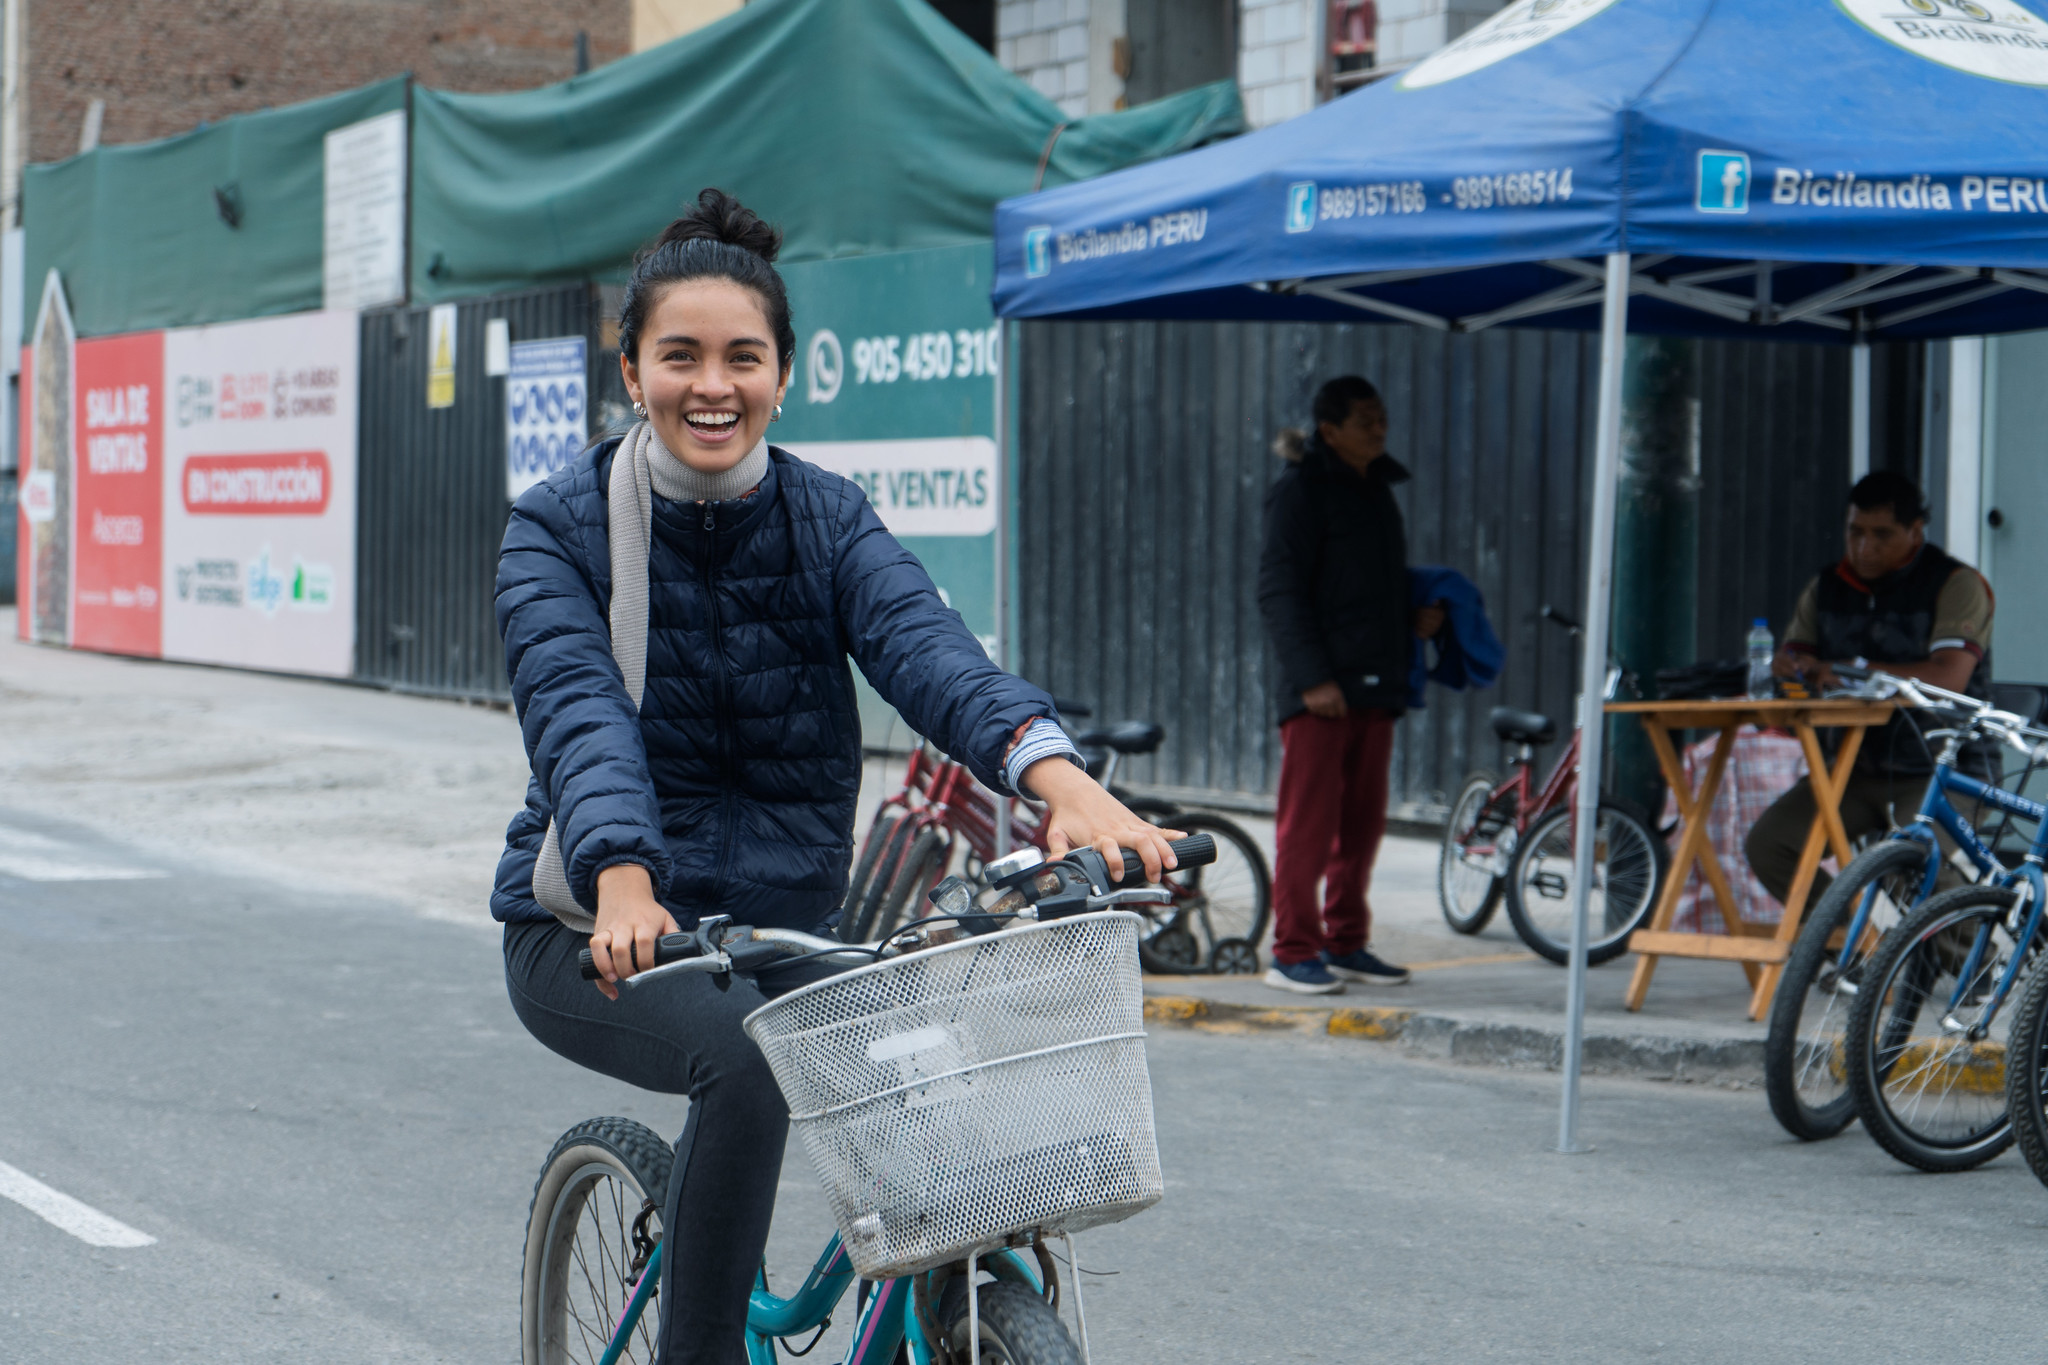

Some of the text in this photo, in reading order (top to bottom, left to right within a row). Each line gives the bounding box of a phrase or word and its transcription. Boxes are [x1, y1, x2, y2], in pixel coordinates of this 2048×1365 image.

[1319, 181, 1427, 220] 989157166
[1772, 167, 1952, 211] Bicilandia
[1056, 207, 1208, 264] Bicilandia PERU
[852, 336, 900, 384] 905
[903, 330, 953, 380] 450
[86, 387, 125, 429] SALA
[127, 384, 150, 426] DE
[88, 431, 149, 474] VENTAS
[210, 456, 324, 504] CONSTRUCCIÓN
[887, 468, 987, 509] VENTAS
